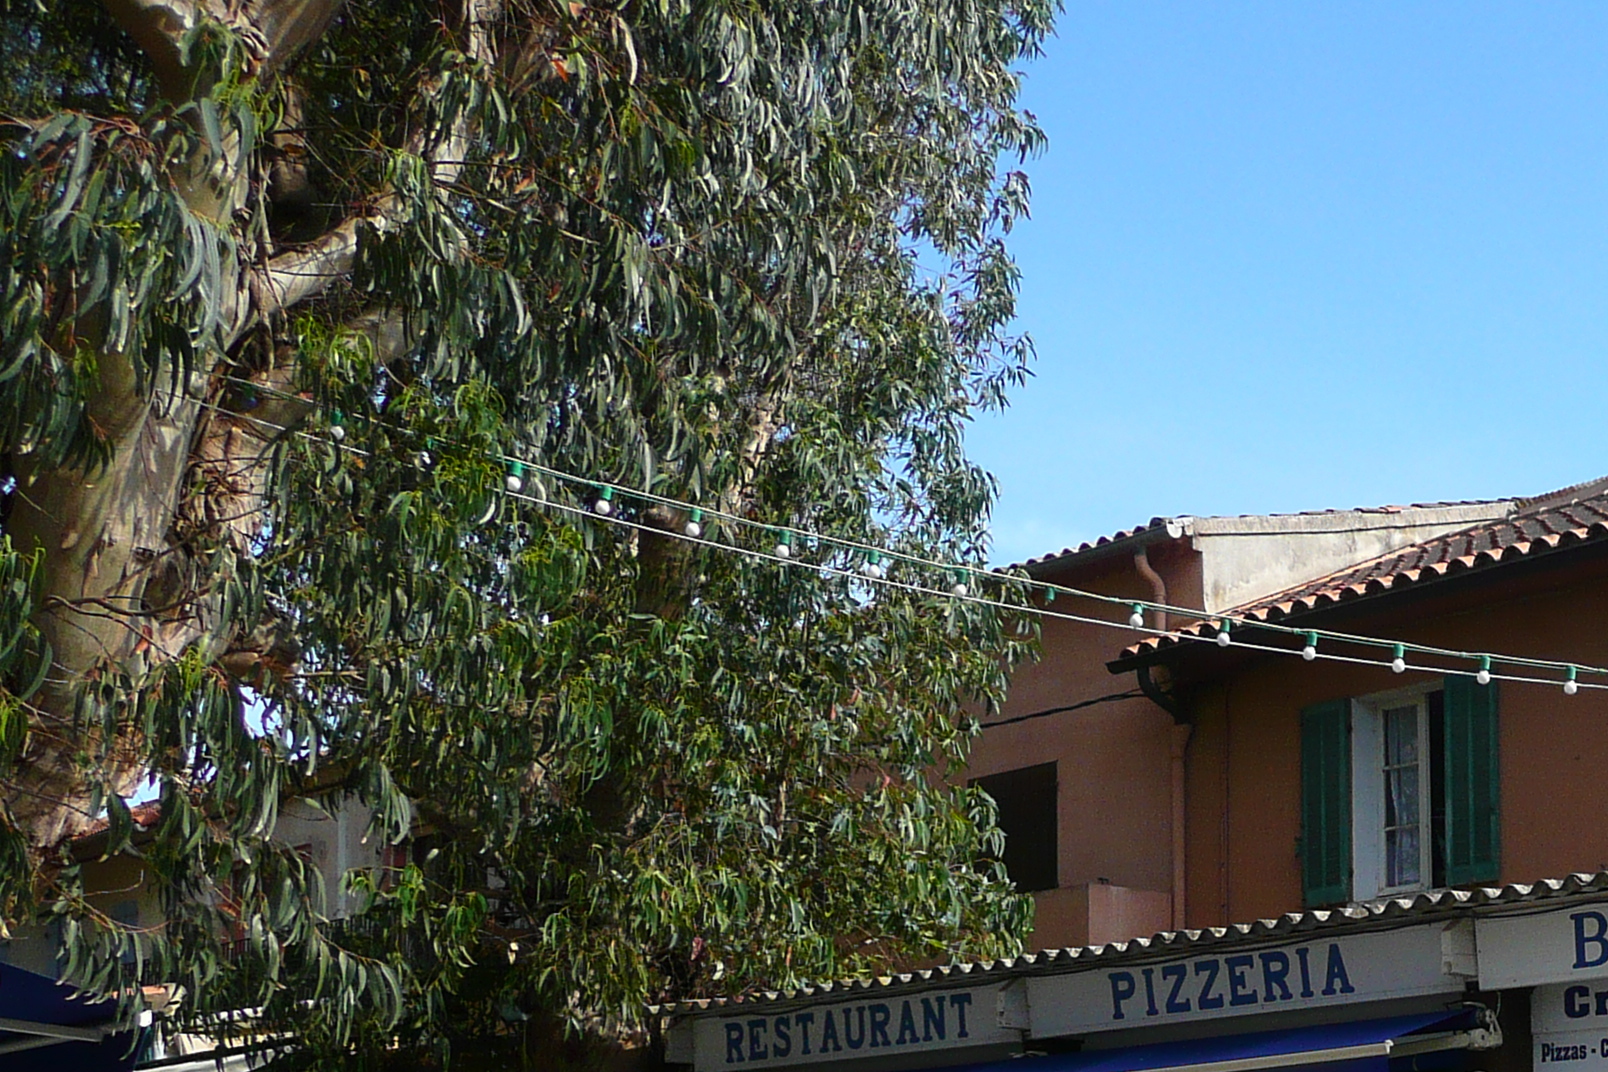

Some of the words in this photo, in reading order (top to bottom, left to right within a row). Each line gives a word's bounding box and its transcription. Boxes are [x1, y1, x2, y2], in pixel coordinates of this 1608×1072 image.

[1108, 943, 1355, 1020] PIZZERIA
[724, 992, 973, 1063] RESTAURANT
[1541, 1042, 1588, 1063] Pizzas
